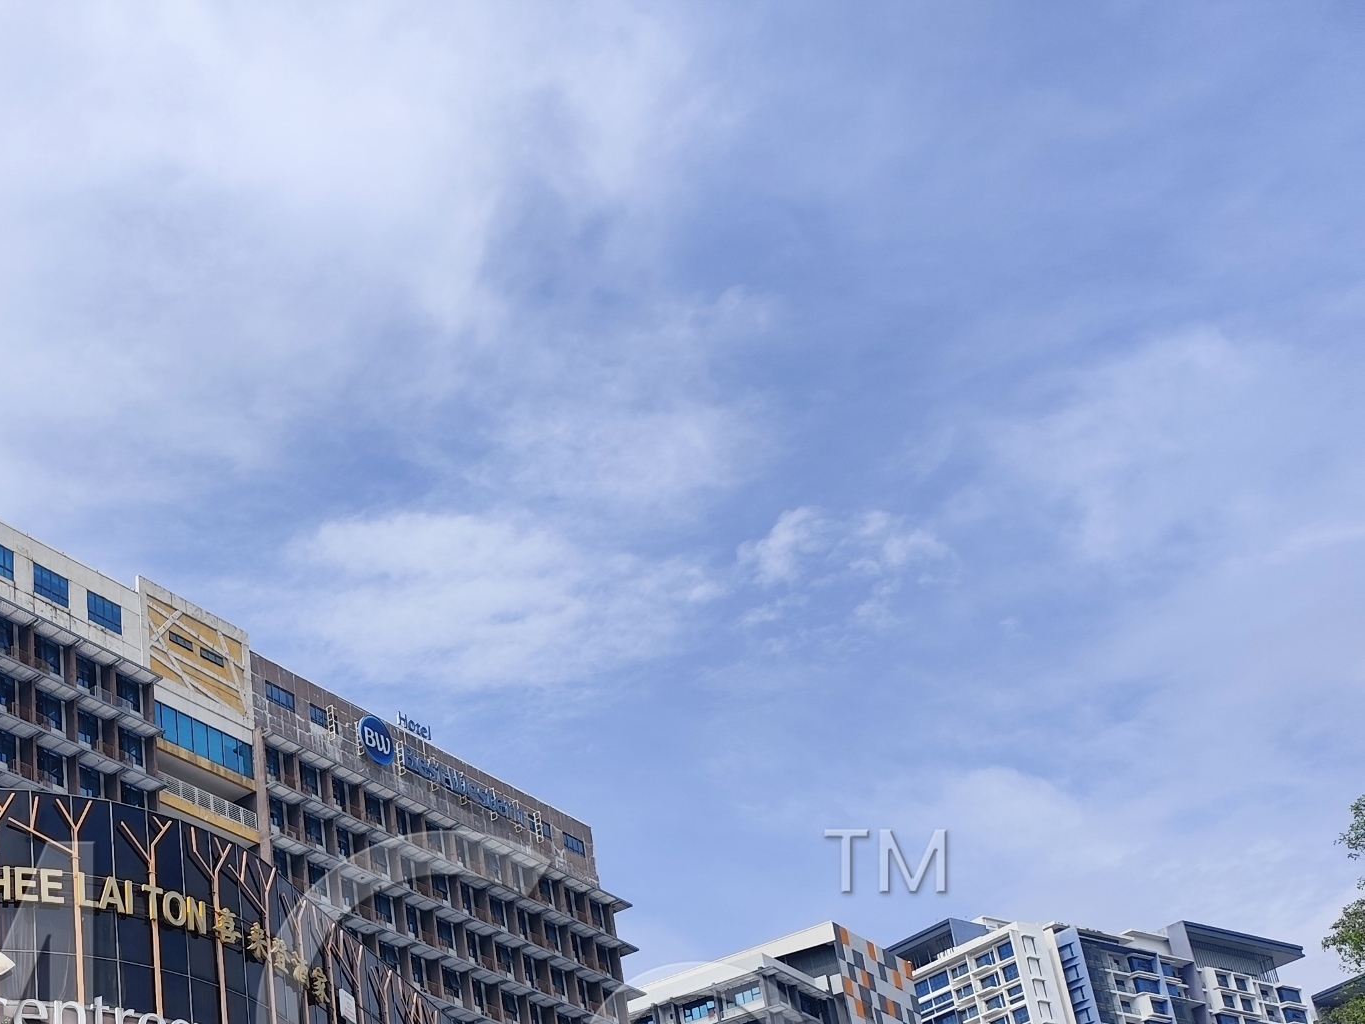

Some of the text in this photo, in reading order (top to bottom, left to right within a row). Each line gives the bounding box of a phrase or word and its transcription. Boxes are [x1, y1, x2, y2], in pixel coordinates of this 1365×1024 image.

[364, 726, 391, 756] BW
[397, 711, 432, 741] Hotel
[401, 743, 526, 824] Best Western
[78, 871, 134, 917] LAI
[143, 883, 207, 935] TON
